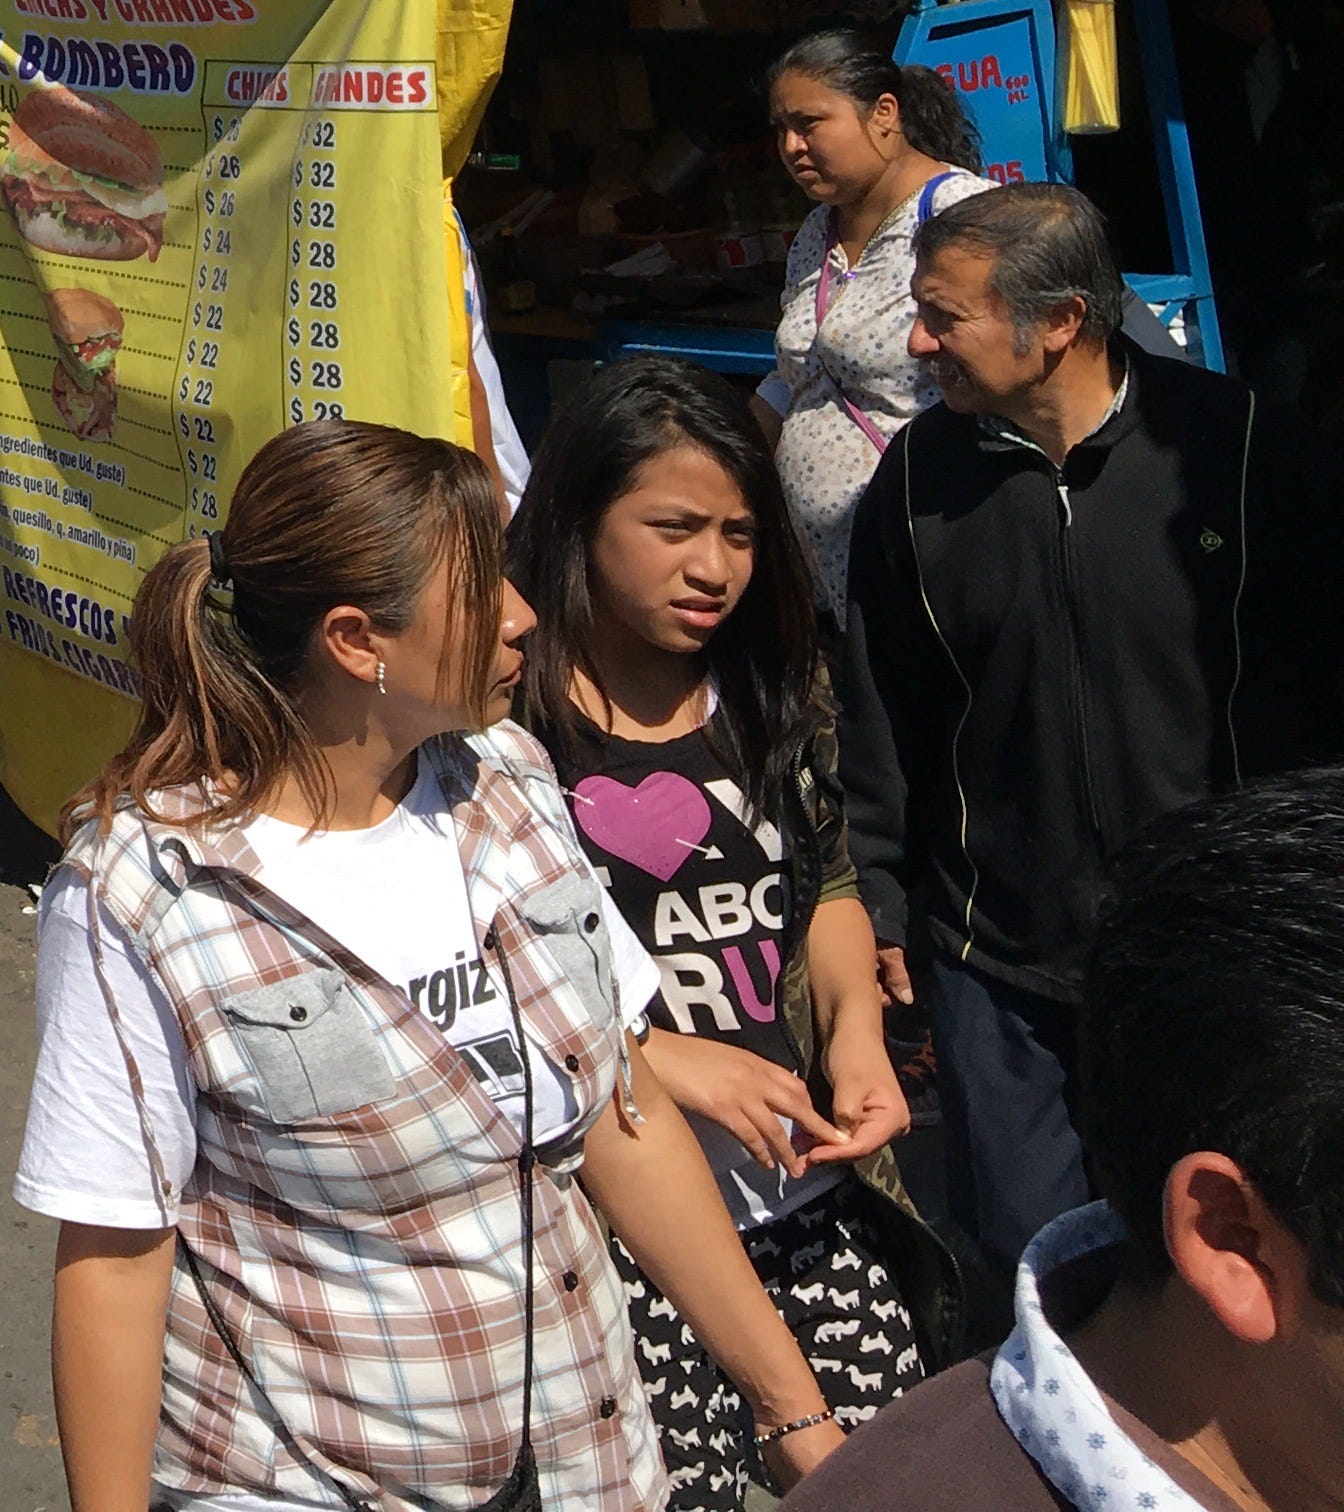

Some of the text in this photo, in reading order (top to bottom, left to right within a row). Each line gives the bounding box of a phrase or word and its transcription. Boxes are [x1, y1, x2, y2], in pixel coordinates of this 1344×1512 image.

[18, 34, 195, 93] BOMBERO
[936, 54, 1003, 93] GUA
[312, 121, 336, 148] 32
[220, 155, 241, 180] 26
[310, 161, 336, 189] 32
[219, 192, 235, 217] 26
[309, 201, 336, 229] 32
[215, 230, 232, 255] 24
[309, 242, 336, 269] 28
[211, 267, 228, 292] 24
[310, 282, 337, 310] 28
[206, 304, 223, 330] 22
[310, 321, 340, 349] 28
[200, 342, 219, 368] 22
[312, 362, 342, 389] 28
[193, 379, 213, 406] 22
[313, 401, 344, 422] 28
[194, 417, 216, 443] 22
[59, 449, 78, 469] que
[95, 461, 126, 489] guste)
[202, 454, 217, 481] 22
[23, 475, 43, 494] que
[61, 487, 93, 513] guste)
[201, 491, 218, 519] 28
[67, 525, 106, 550] amarillo
[2, 564, 118, 647] REFRESCOS
